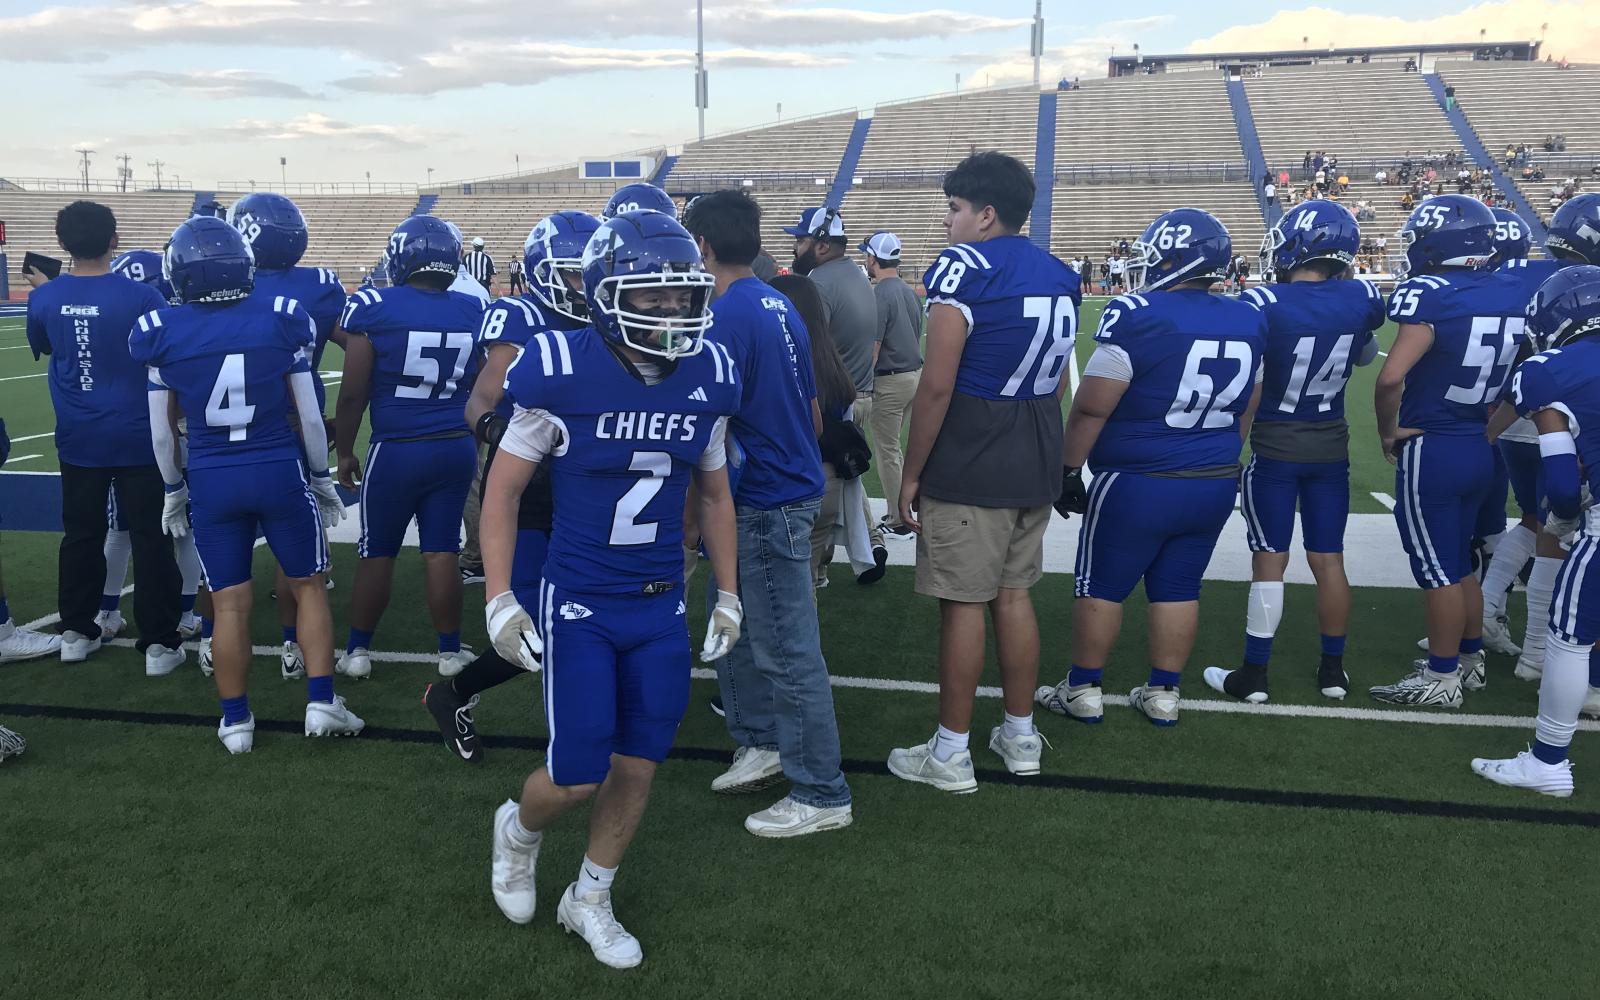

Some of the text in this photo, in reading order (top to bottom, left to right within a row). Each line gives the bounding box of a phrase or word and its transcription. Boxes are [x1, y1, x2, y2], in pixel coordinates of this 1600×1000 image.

[238, 213, 261, 243] 59
[1294, 210, 1318, 231] 14
[1416, 206, 1450, 228] 55
[1495, 221, 1520, 241] 56
[391, 232, 408, 254] 57
[1160, 225, 1192, 249] 62
[123, 262, 145, 282] 19
[928, 256, 966, 293] 78
[211, 288, 241, 298] schutt
[1390, 288, 1423, 317] 55
[61, 305, 100, 316] CAGE
[1000, 296, 1076, 397] 78
[1445, 317, 1526, 405] 55
[395, 331, 473, 399] 57
[1278, 334, 1354, 413] 14
[205, 354, 256, 442] 4
[1165, 340, 1252, 429] 62
[596, 412, 698, 441] CHIEFS
[609, 451, 672, 545] 2
